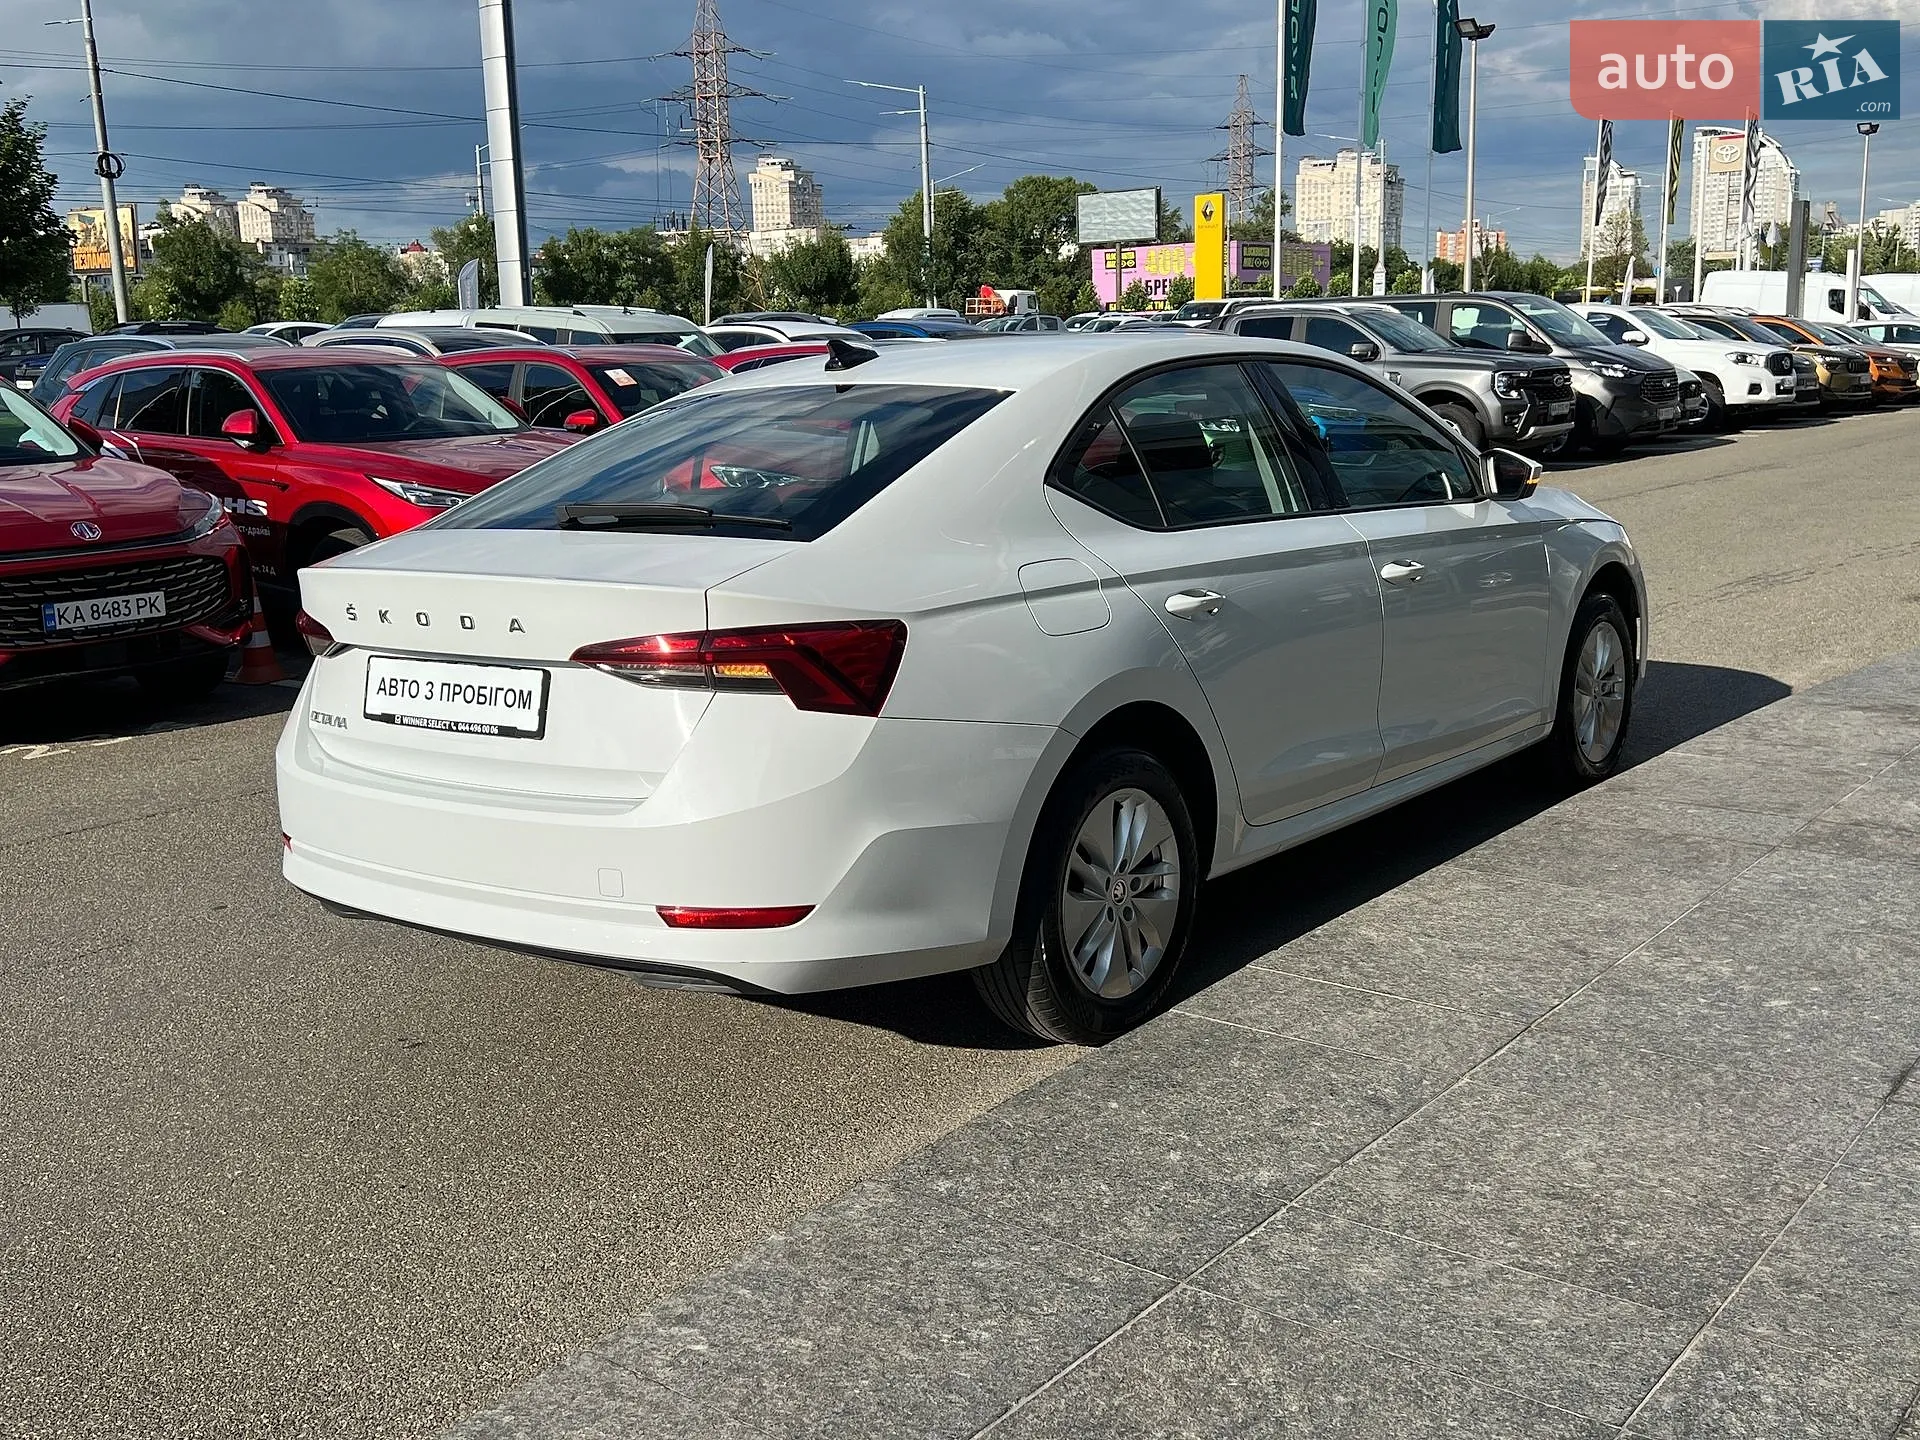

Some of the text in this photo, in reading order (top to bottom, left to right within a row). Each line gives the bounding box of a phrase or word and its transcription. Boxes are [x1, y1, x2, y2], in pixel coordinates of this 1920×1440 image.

[223, 497, 268, 516] HS
[57, 595, 161, 625] KA 8483 PK
[346, 603, 526, 634] ŠKODA
[376, 677, 420, 699] АВТО
[439, 683, 533, 710] ПРОБІГОМ
[402, 715, 428, 727] WINNER
[428, 719, 450, 730] SELECT
[458, 722, 469, 732] 044
